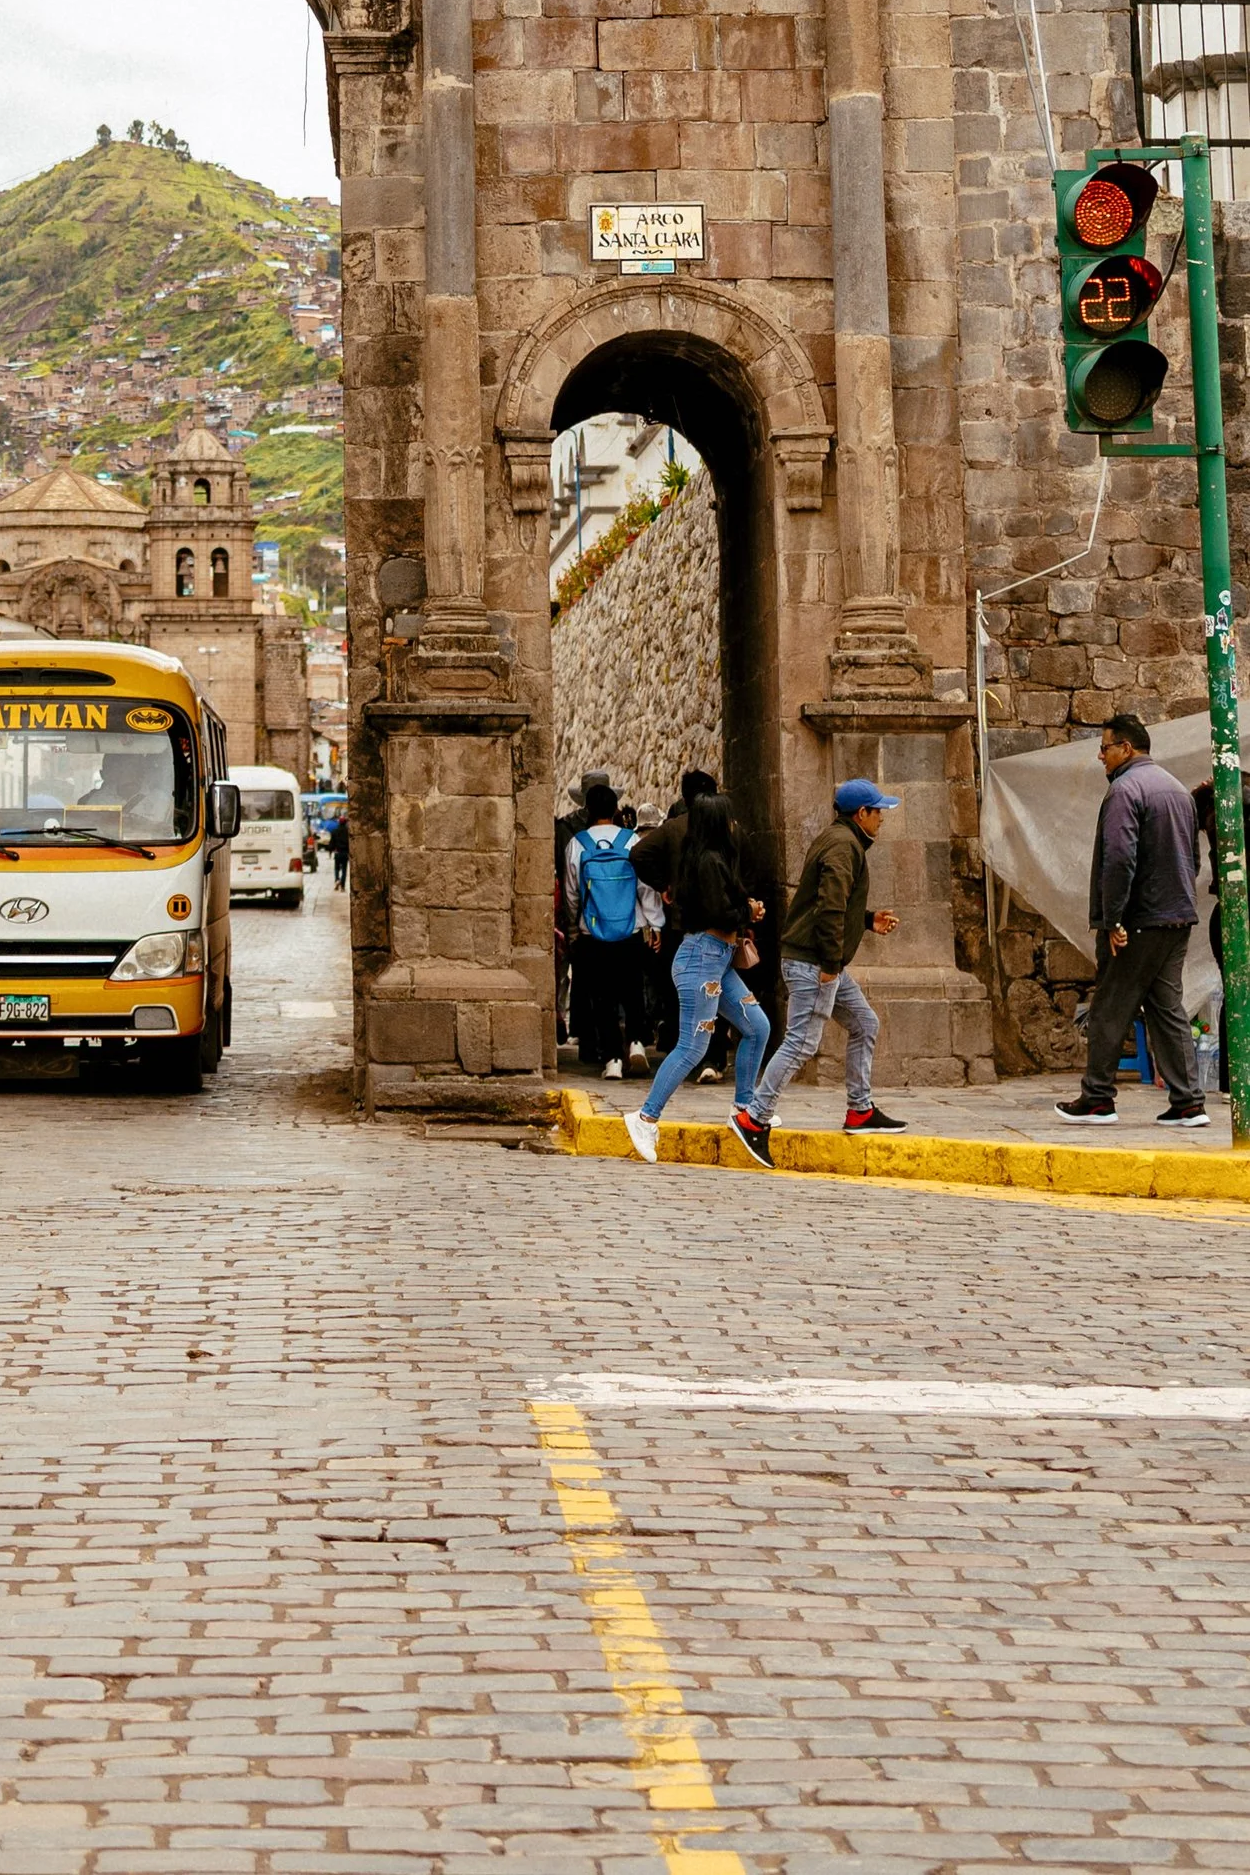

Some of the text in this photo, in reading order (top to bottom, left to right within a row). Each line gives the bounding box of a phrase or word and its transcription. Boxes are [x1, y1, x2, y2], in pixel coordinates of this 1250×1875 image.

[636, 212, 684, 227] ARCO
[598, 231, 700, 248] SANTA CLARA
[1081, 277, 1131, 323] 22
